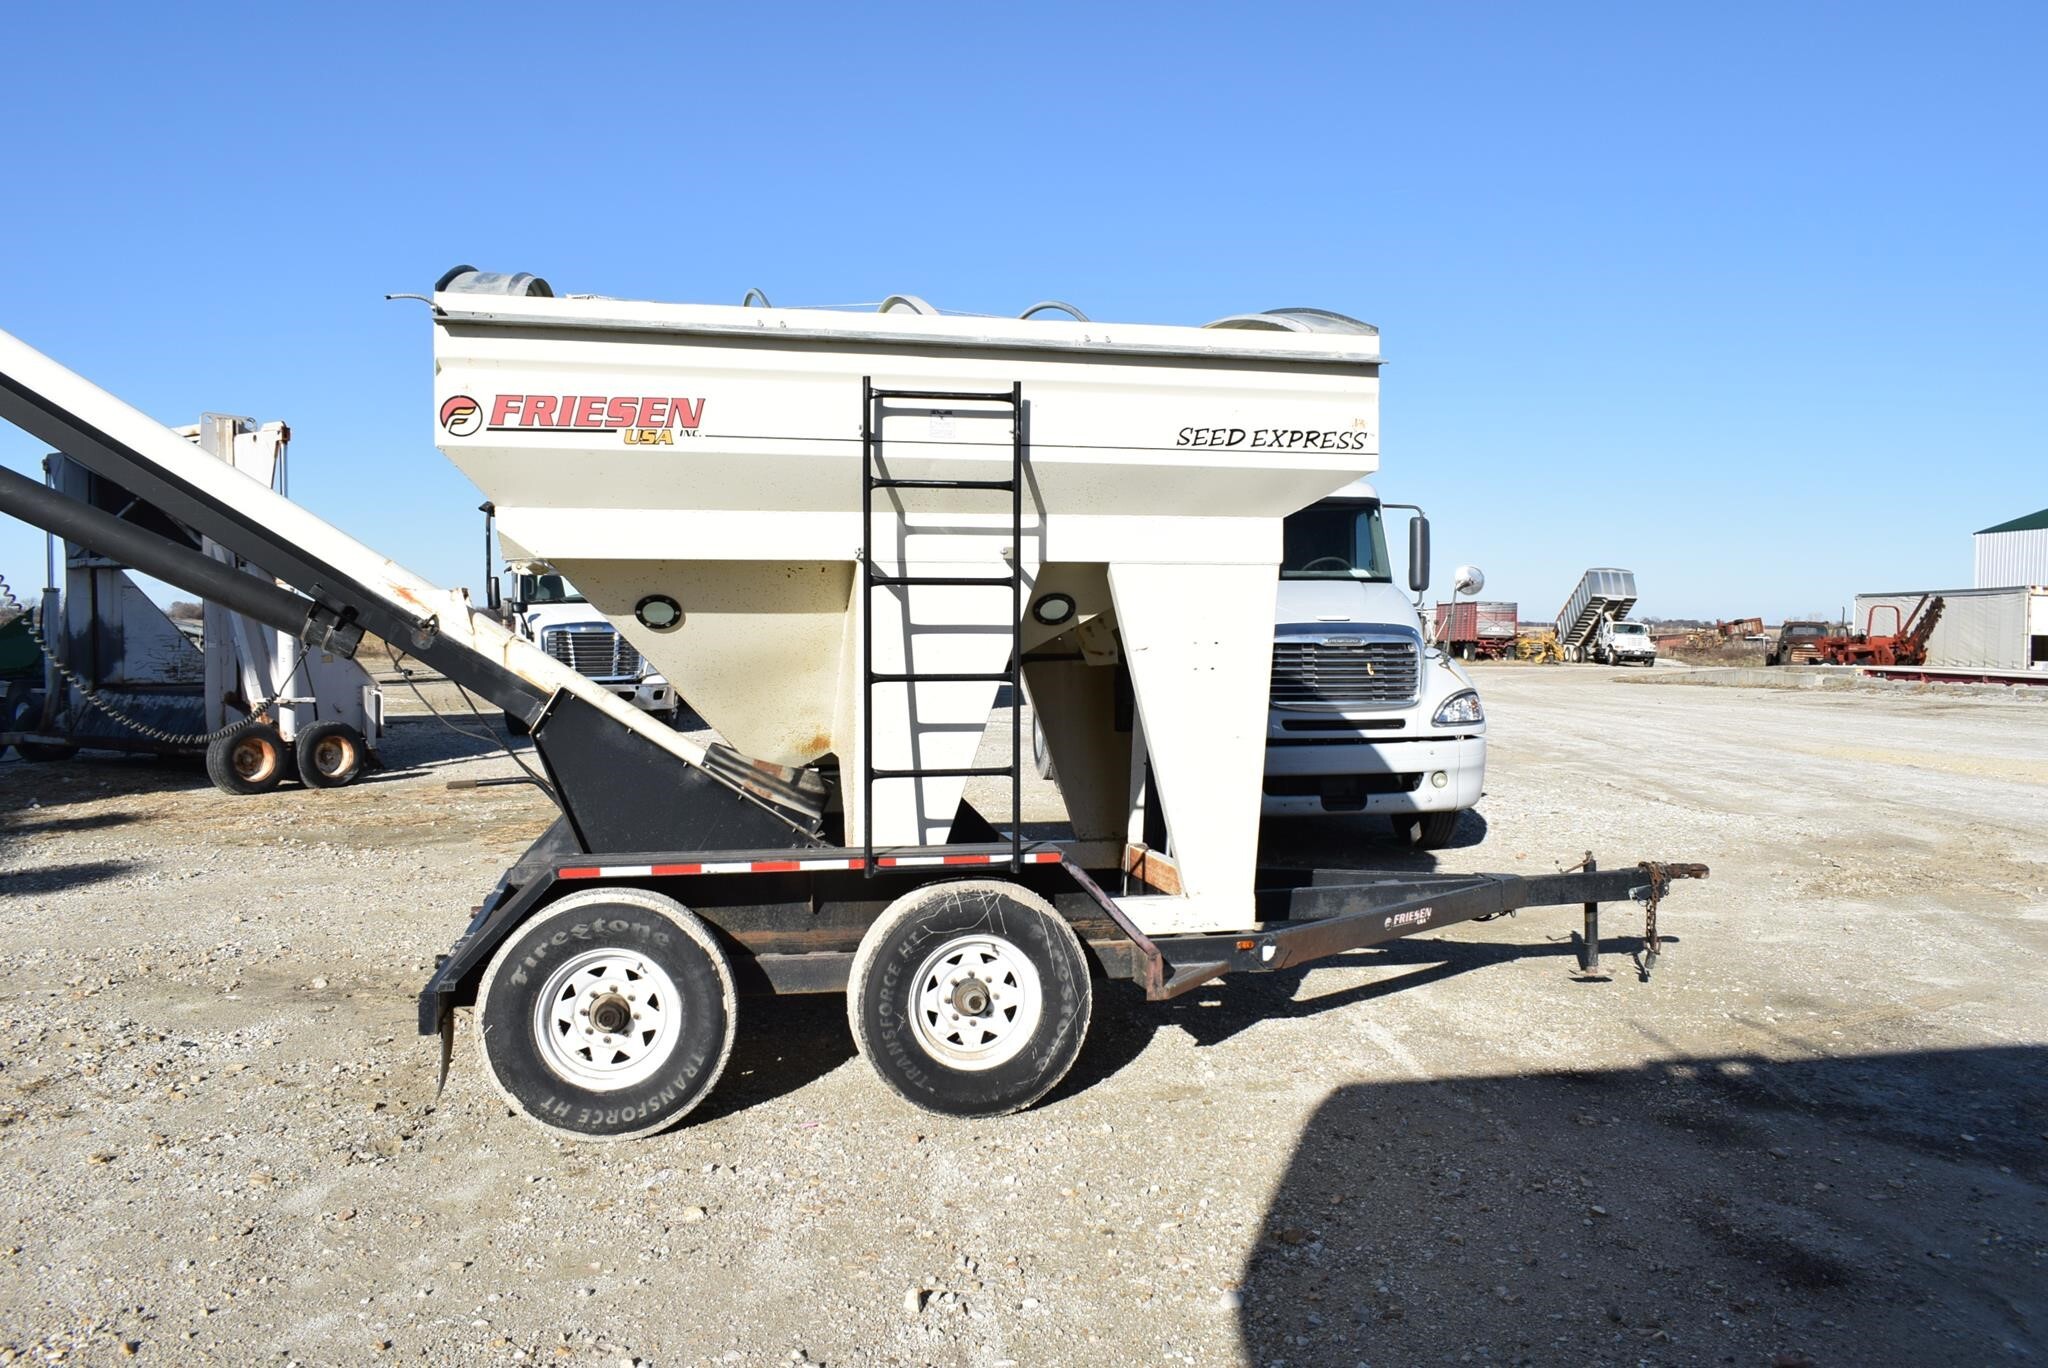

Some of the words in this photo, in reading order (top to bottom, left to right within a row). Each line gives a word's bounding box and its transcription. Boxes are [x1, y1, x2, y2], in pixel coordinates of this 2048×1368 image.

[489, 394, 706, 429] FRIESEN
[623, 428, 674, 446] USA
[679, 429, 702, 438] INC.
[1176, 427, 1246, 447] SEED
[1250, 429, 1367, 450] EXPRESS
[1393, 907, 1432, 925] FRIESEN
[508, 918, 670, 986] Firestone
[878, 961, 932, 1091] TRANSFORCE
[578, 1052, 706, 1126] TRANSFORCE
[540, 1094, 572, 1118] HT
